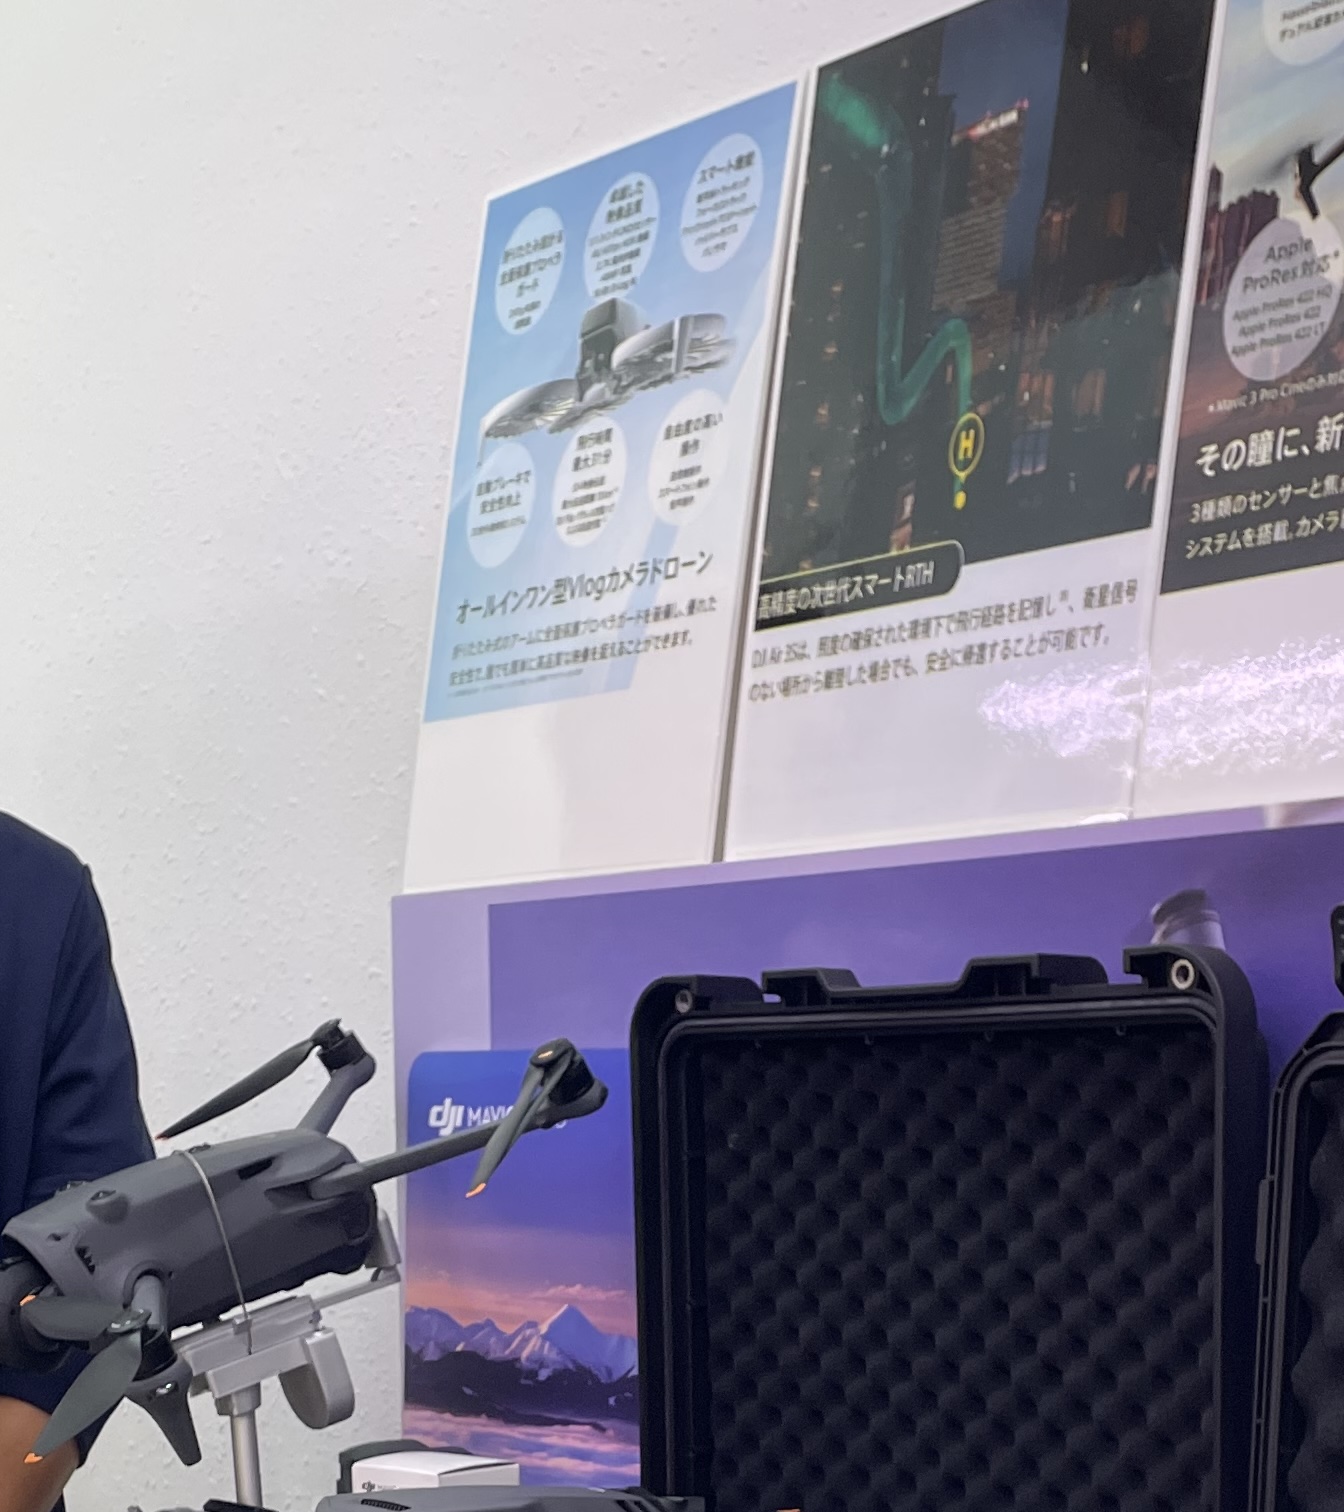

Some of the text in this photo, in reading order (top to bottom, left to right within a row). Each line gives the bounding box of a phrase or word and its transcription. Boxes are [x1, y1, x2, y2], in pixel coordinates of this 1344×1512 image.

[1264, 238, 1315, 266] Apple
[457, 551, 713, 625] オールインワン型Vlogカメラドローン
